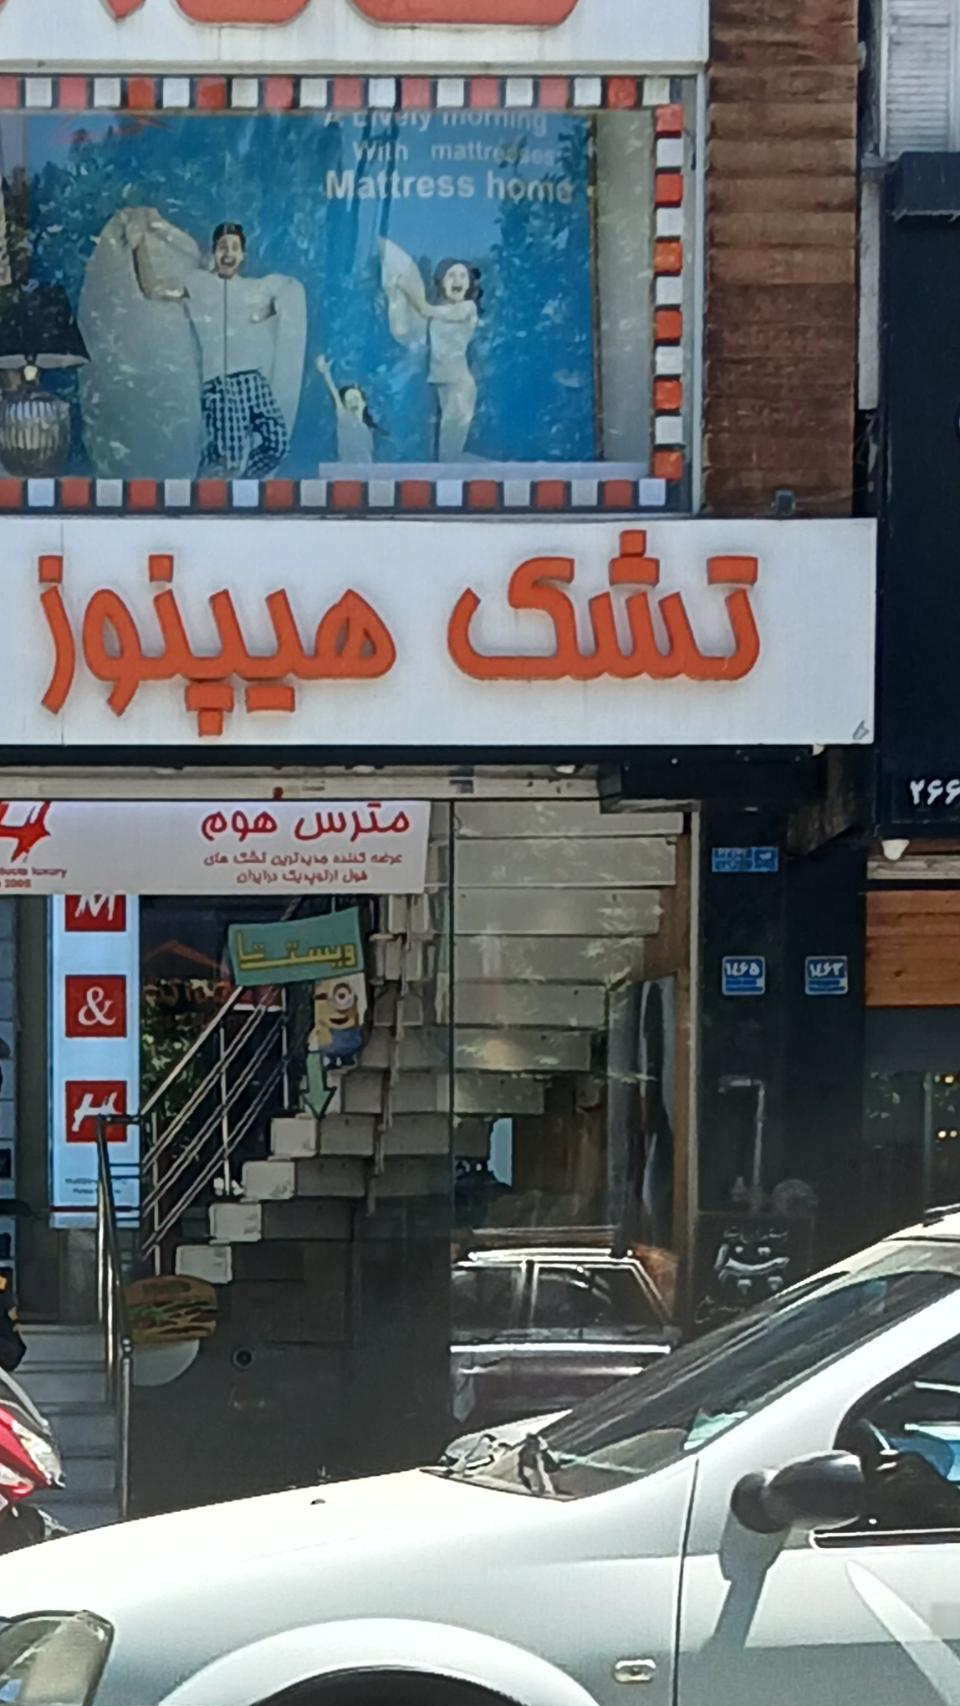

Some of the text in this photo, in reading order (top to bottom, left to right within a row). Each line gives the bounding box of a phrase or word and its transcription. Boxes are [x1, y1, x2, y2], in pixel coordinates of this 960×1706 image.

[323, 111, 344, 127] A
[442, 111, 547, 137] morning
[352, 141, 409, 162] With
[326, 170, 577, 203] Mattress home
[38, 530, 760, 738] تشک هیپنوز
[201, 802, 410, 842] مترس هوم
[77, 986, 116, 1026] &
